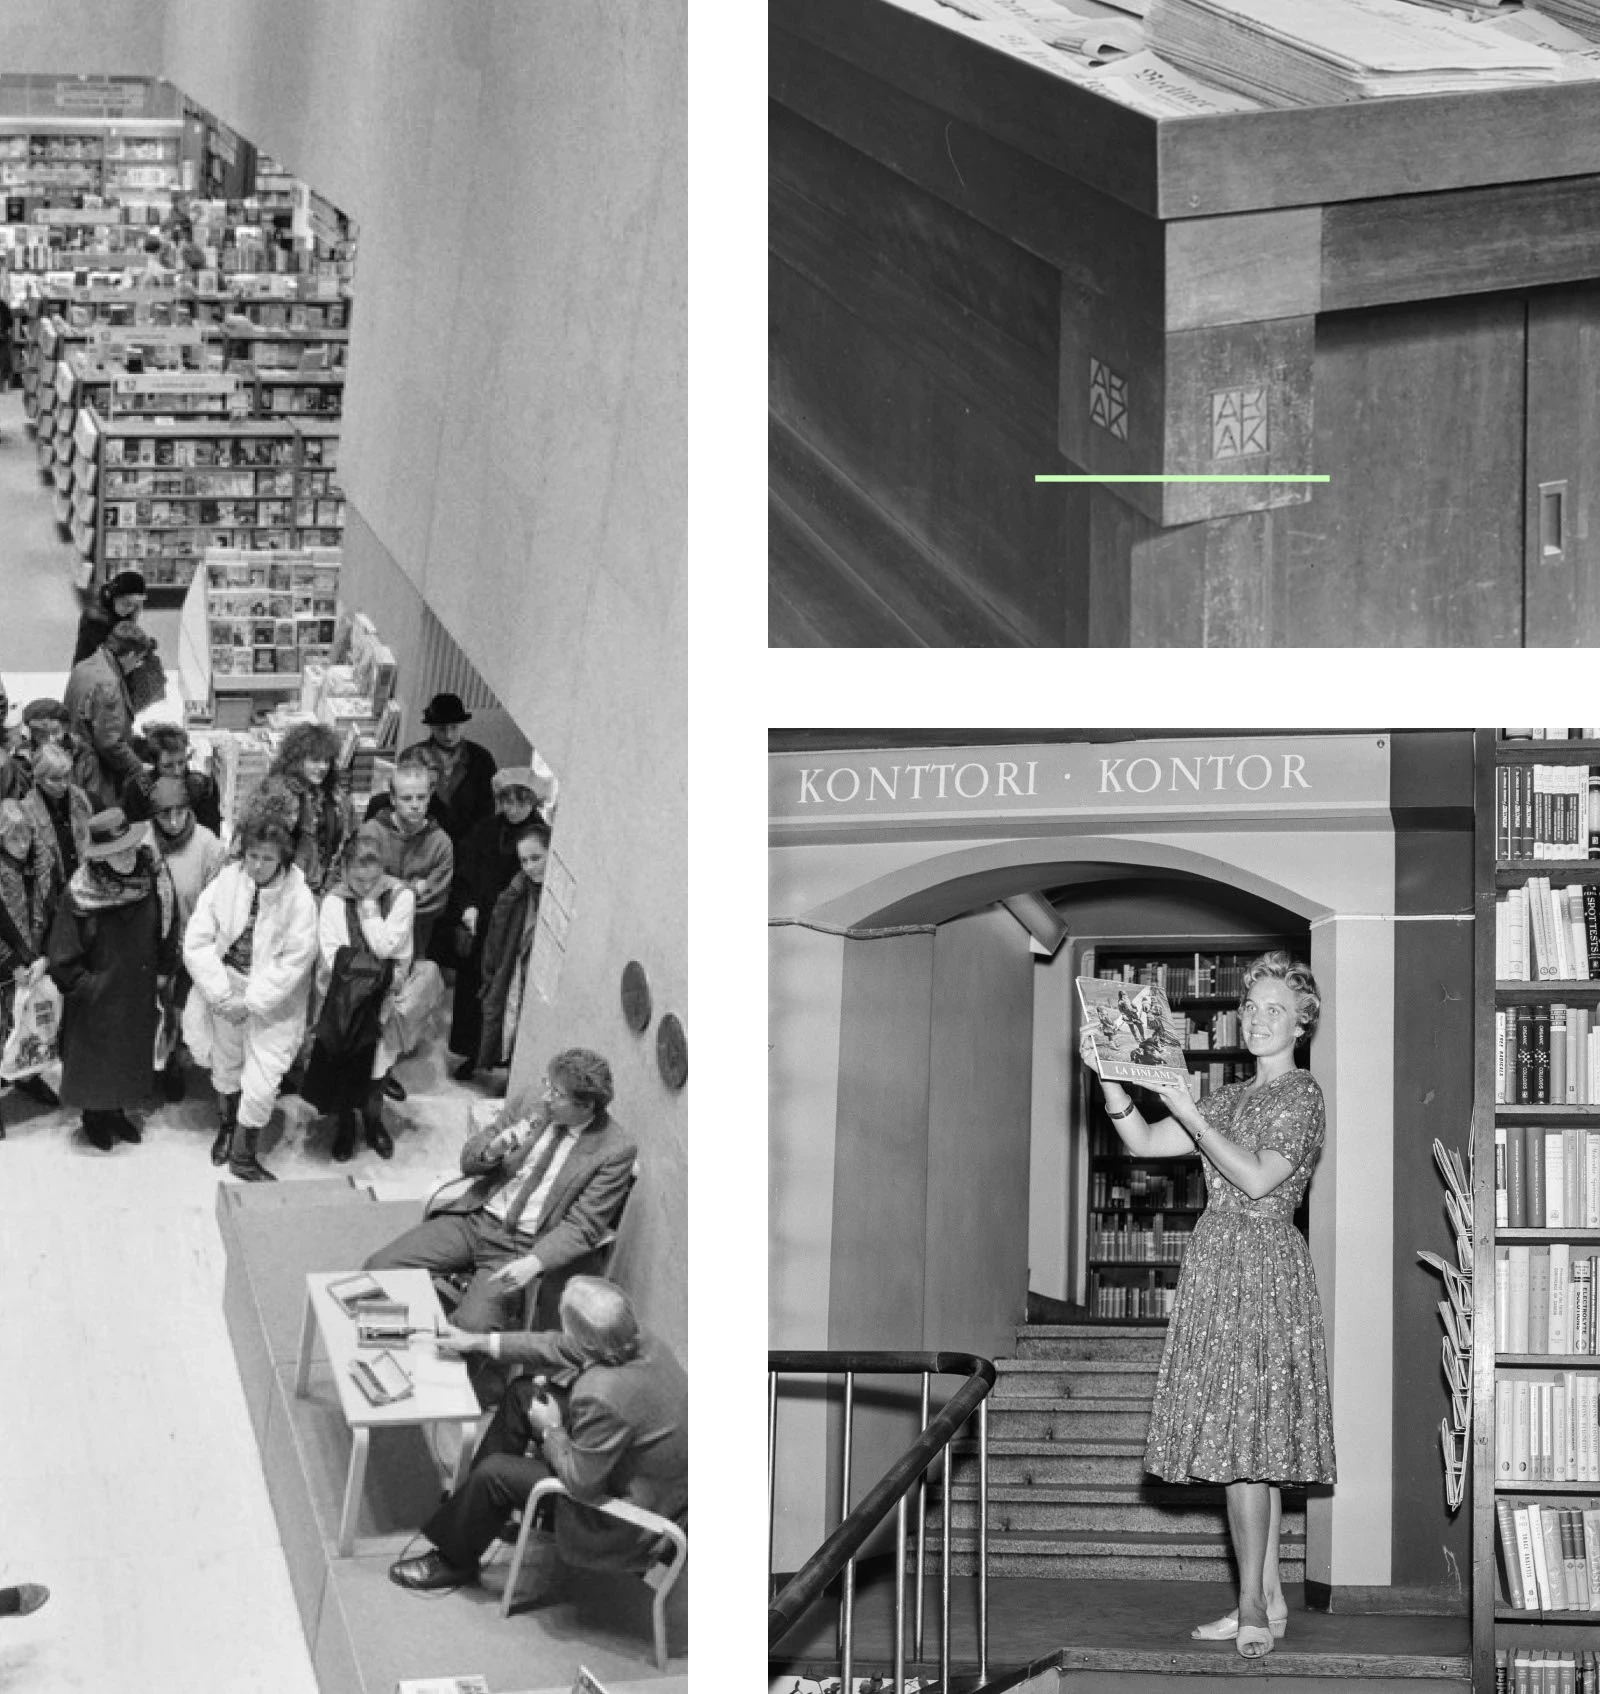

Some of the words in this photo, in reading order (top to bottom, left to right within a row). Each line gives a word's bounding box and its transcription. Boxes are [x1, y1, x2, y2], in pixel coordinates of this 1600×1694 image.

[796, 761, 1040, 804] KONTTORI
[1097, 754, 1313, 793] KONTOR
[1587, 897, 1597, 923] SPOT
[1589, 923, 1599, 953] TESTS
[1114, 1065, 1129, 1076] LA
[1521, 1533, 1529, 1550] TRACE
[1524, 1553, 1533, 1578] ANALYSIS
